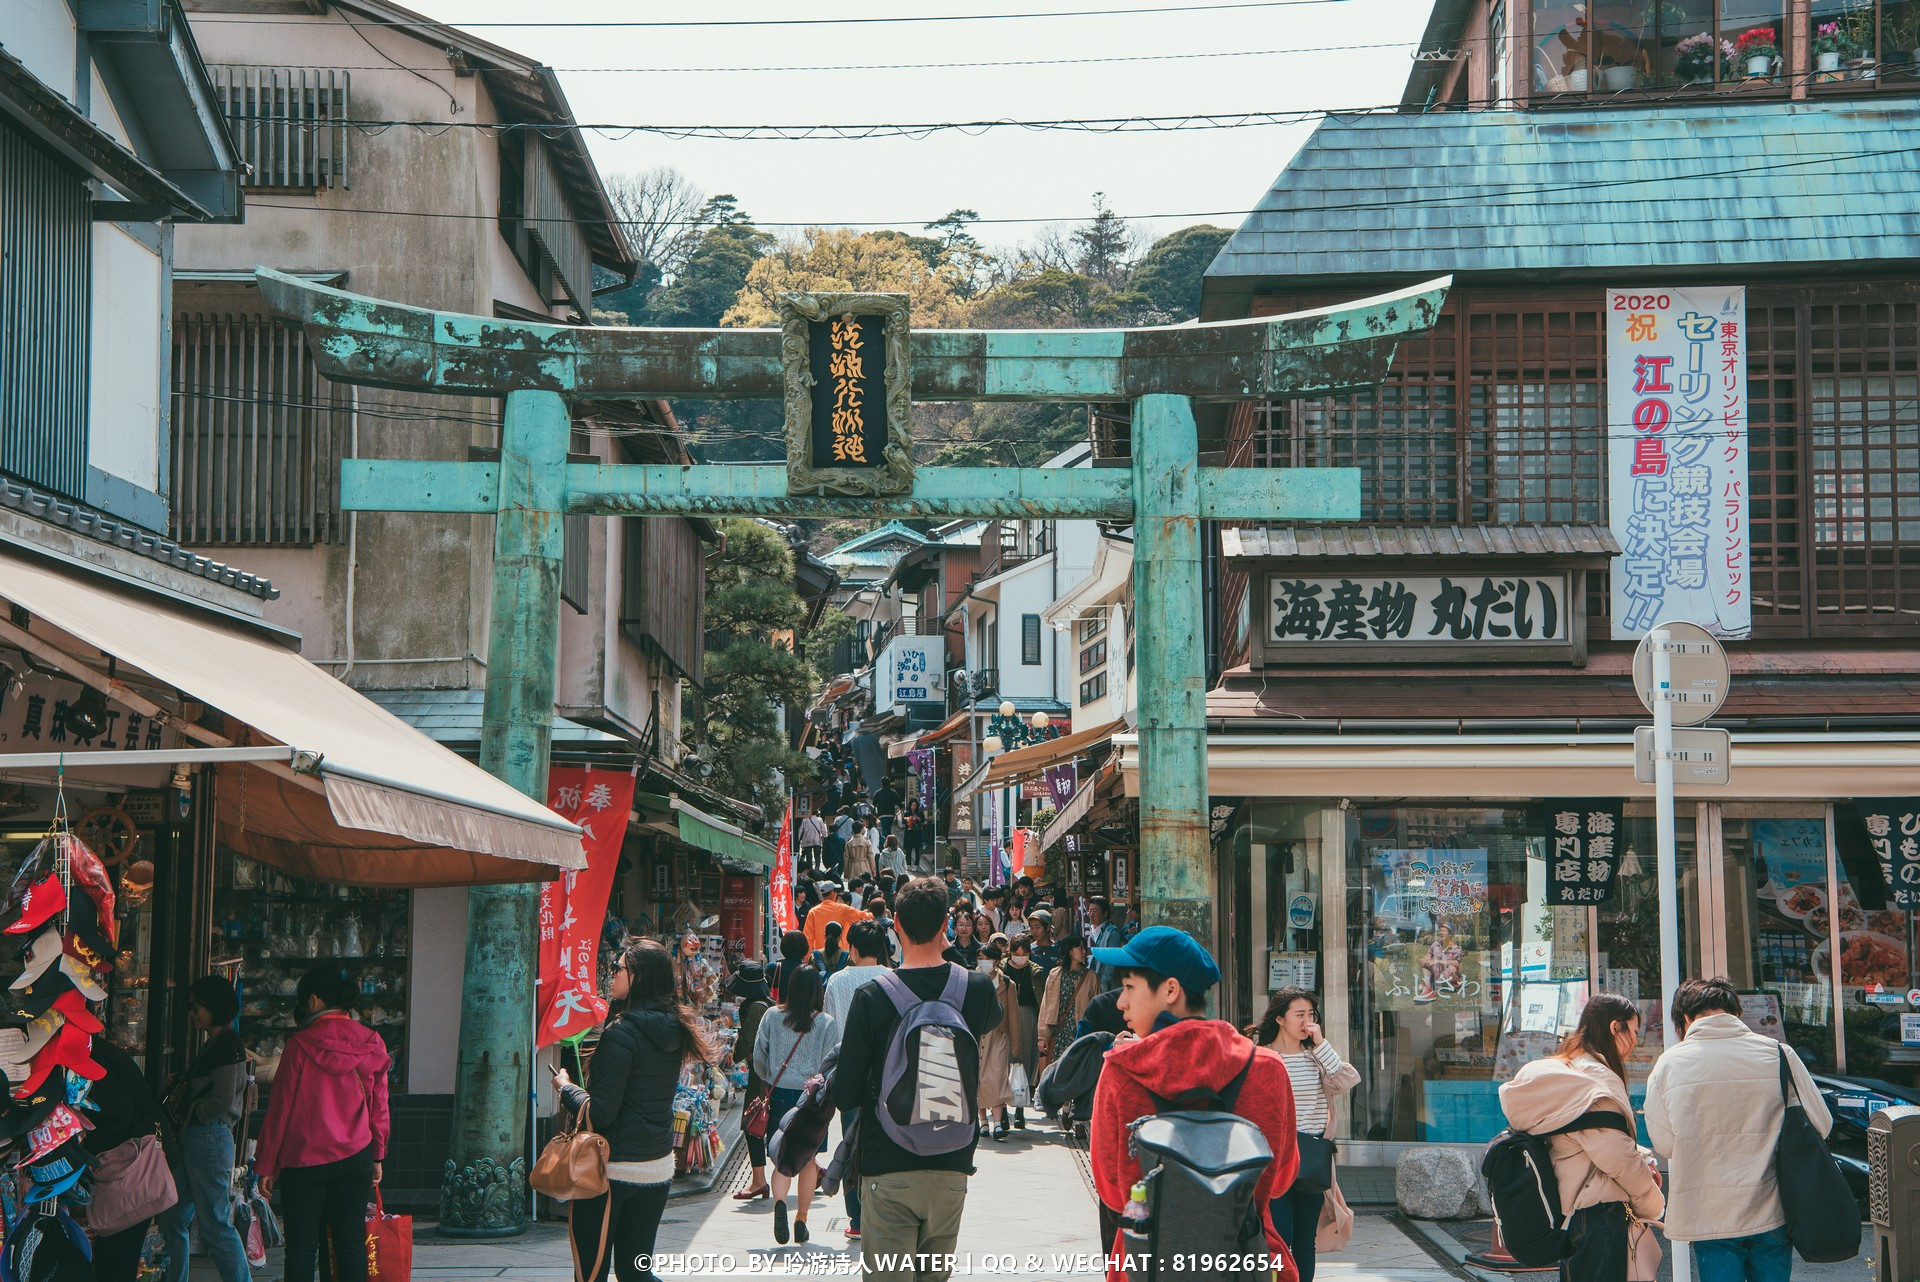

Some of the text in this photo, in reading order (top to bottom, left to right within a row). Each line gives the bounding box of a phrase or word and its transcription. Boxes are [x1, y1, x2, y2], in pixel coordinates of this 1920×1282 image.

[1613, 294, 1671, 311] 2020
[1625, 312, 1658, 343] 祝
[1666, 311, 1719, 590] セーリング競技会場
[1719, 321, 1744, 605] 東京オリンピック・パラリンピック
[1273, 577, 1558, 640] 海産物 丸だい
[22, 693, 162, 751] 真珠工芸品
[1555, 812, 1582, 882] 専門店
[1587, 811, 1615, 882] 海産物
[1561, 886, 1605, 901] 丸だい
[918, 1030, 963, 1123] NIKE
